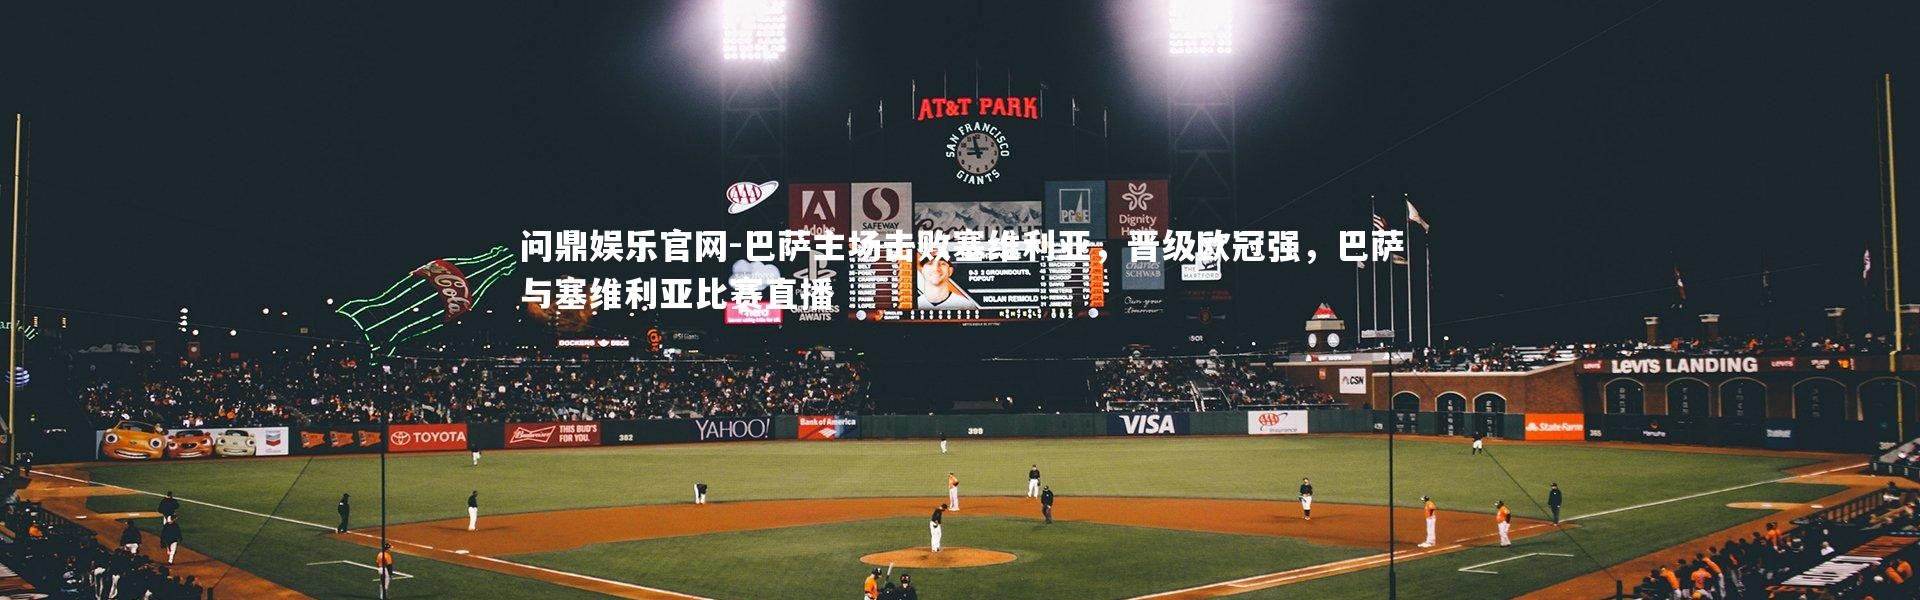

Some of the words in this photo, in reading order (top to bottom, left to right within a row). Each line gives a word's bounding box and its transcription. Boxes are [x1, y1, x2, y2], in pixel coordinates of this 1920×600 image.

[918, 98, 972, 120] AT&T
[979, 97, 1038, 119] PARK
[945, 133, 960, 158] SAN
[957, 121, 1010, 157] FRANCISCO
[956, 169, 1001, 185] GIANTS
[862, 222, 899, 230] SAFEWAY
[1120, 214, 1158, 227] Dignity
[1125, 270, 1161, 278] SCHWAB
[799, 313, 833, 321] AWAITS
[1665, 356, 1759, 374] LANDING
[1349, 375, 1365, 385] CSN
[800, 418, 818, 426] Bank
[827, 417, 857, 426] America
[1118, 414, 1176, 435] VISA
[559, 425, 575, 434] THIS
[576, 424, 598, 433] BUD'S
[695, 418, 771, 441] YAHOO!
[413, 431, 467, 443] TOYOTA
[559, 434, 574, 443] FOR
[574, 434, 590, 442] YOU.
